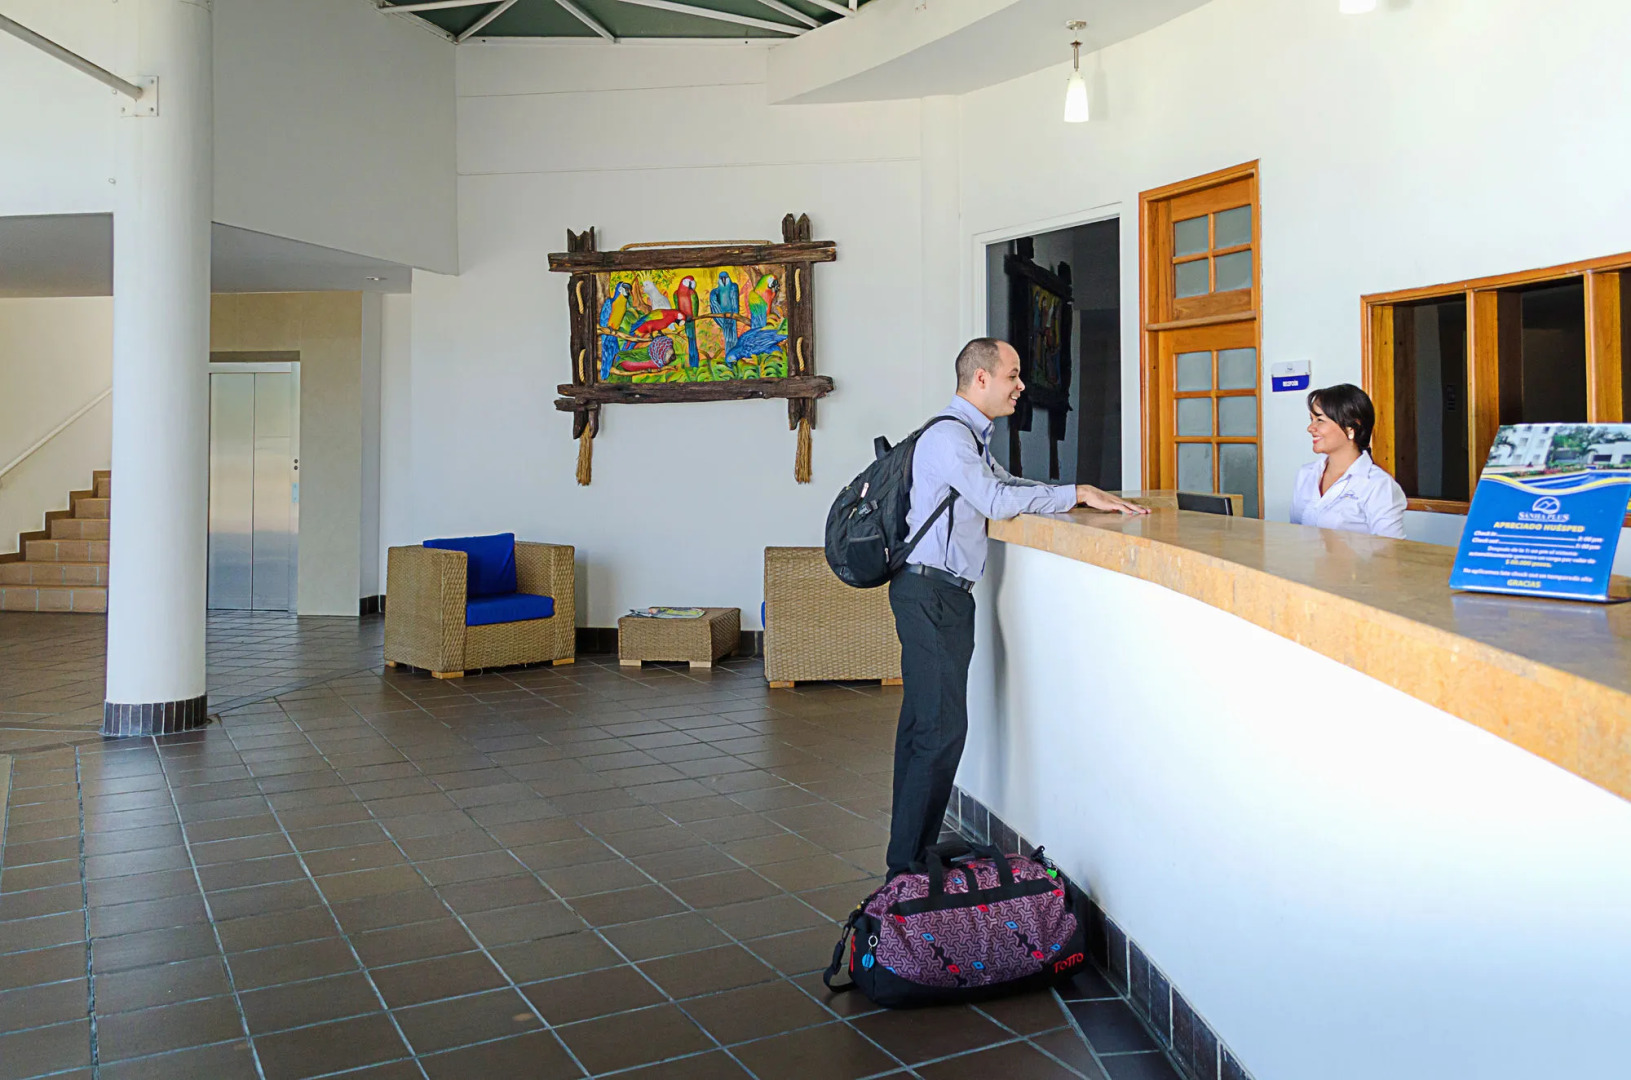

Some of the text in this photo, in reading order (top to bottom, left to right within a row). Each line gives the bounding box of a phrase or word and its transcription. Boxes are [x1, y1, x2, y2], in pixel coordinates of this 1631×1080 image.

[1494, 521, 1542, 530] APRECIADO
[1507, 579, 1541, 588] GRACIAS
[1053, 952, 1084, 974] TOTTO
